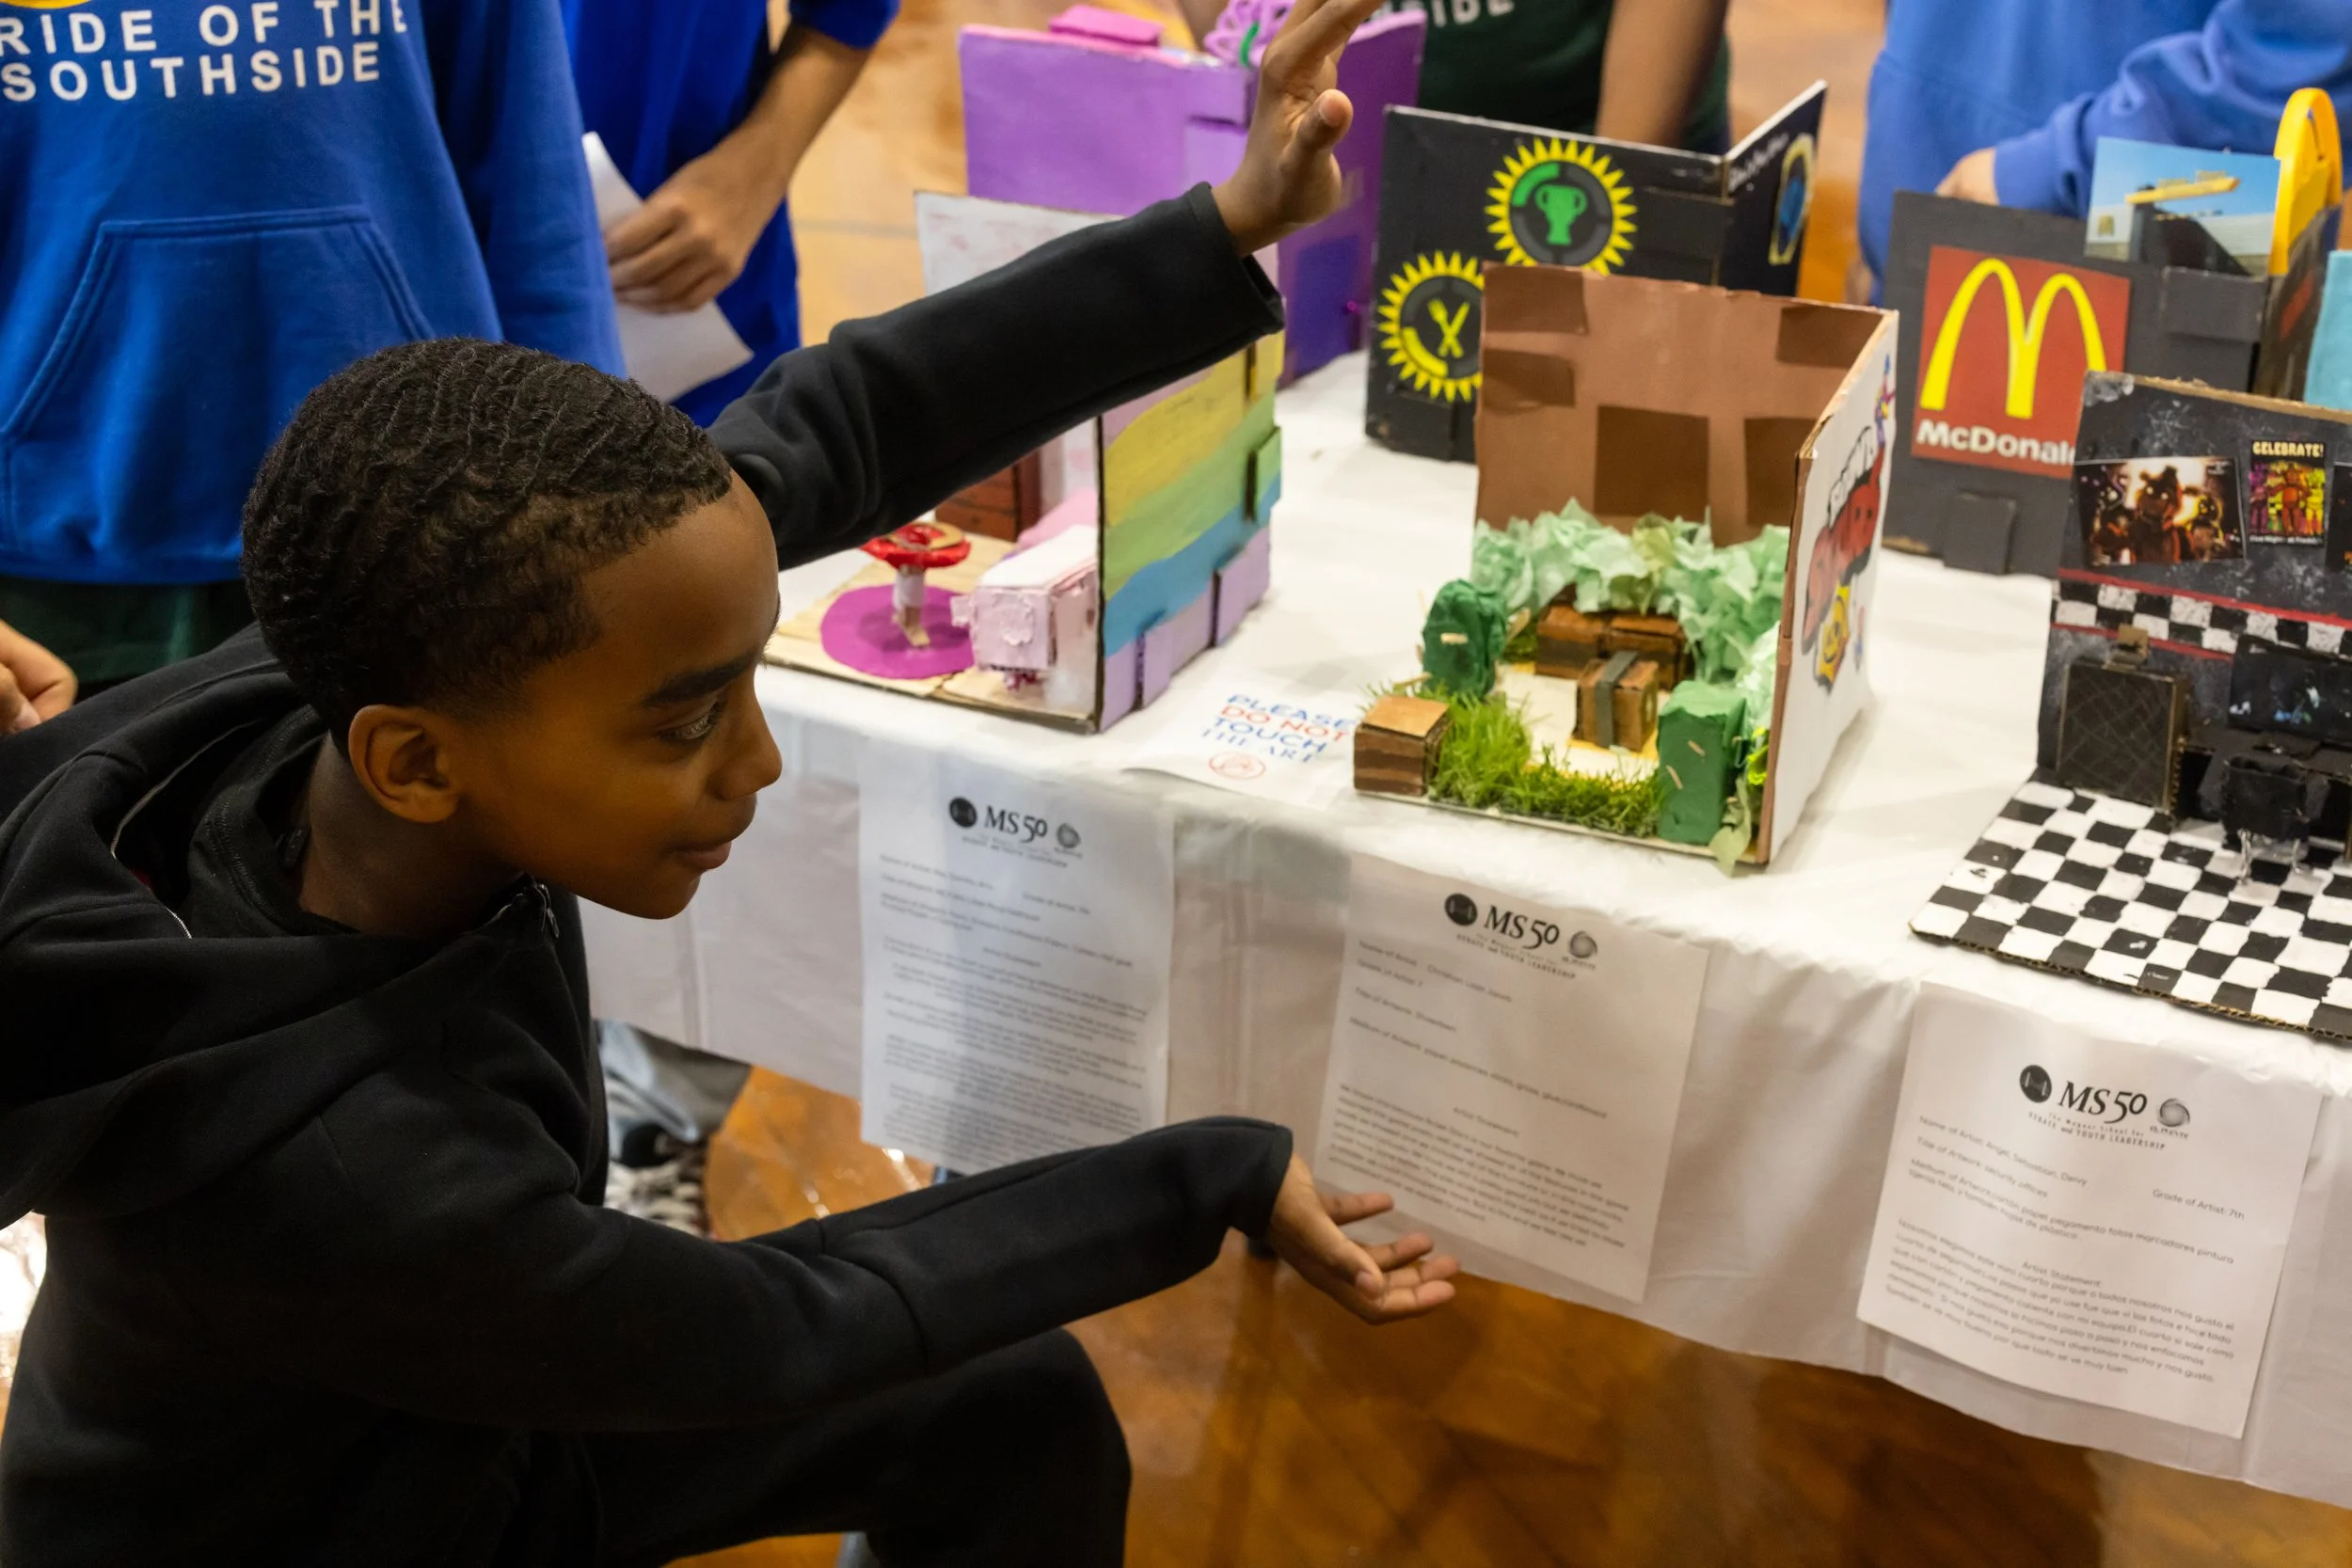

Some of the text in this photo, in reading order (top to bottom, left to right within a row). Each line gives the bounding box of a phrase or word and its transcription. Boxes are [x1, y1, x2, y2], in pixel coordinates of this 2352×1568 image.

[0, 0, 408, 55] RIDE OF THE
[2, 42, 379, 101] SOUTHSIDE
[2251, 440, 2325, 459] CELEBRATE!
[1221, 705, 1351, 742] DO NOT
[1228, 694, 1356, 729] PLEASE
[1215, 717, 1327, 752] TOUCH
[2152, 1187, 2183, 1203] Grade
[2227, 1208, 2246, 1220] 7th
[2127, 1298, 2172, 1313] nosotros
[2173, 1308, 2193, 1319] nos
